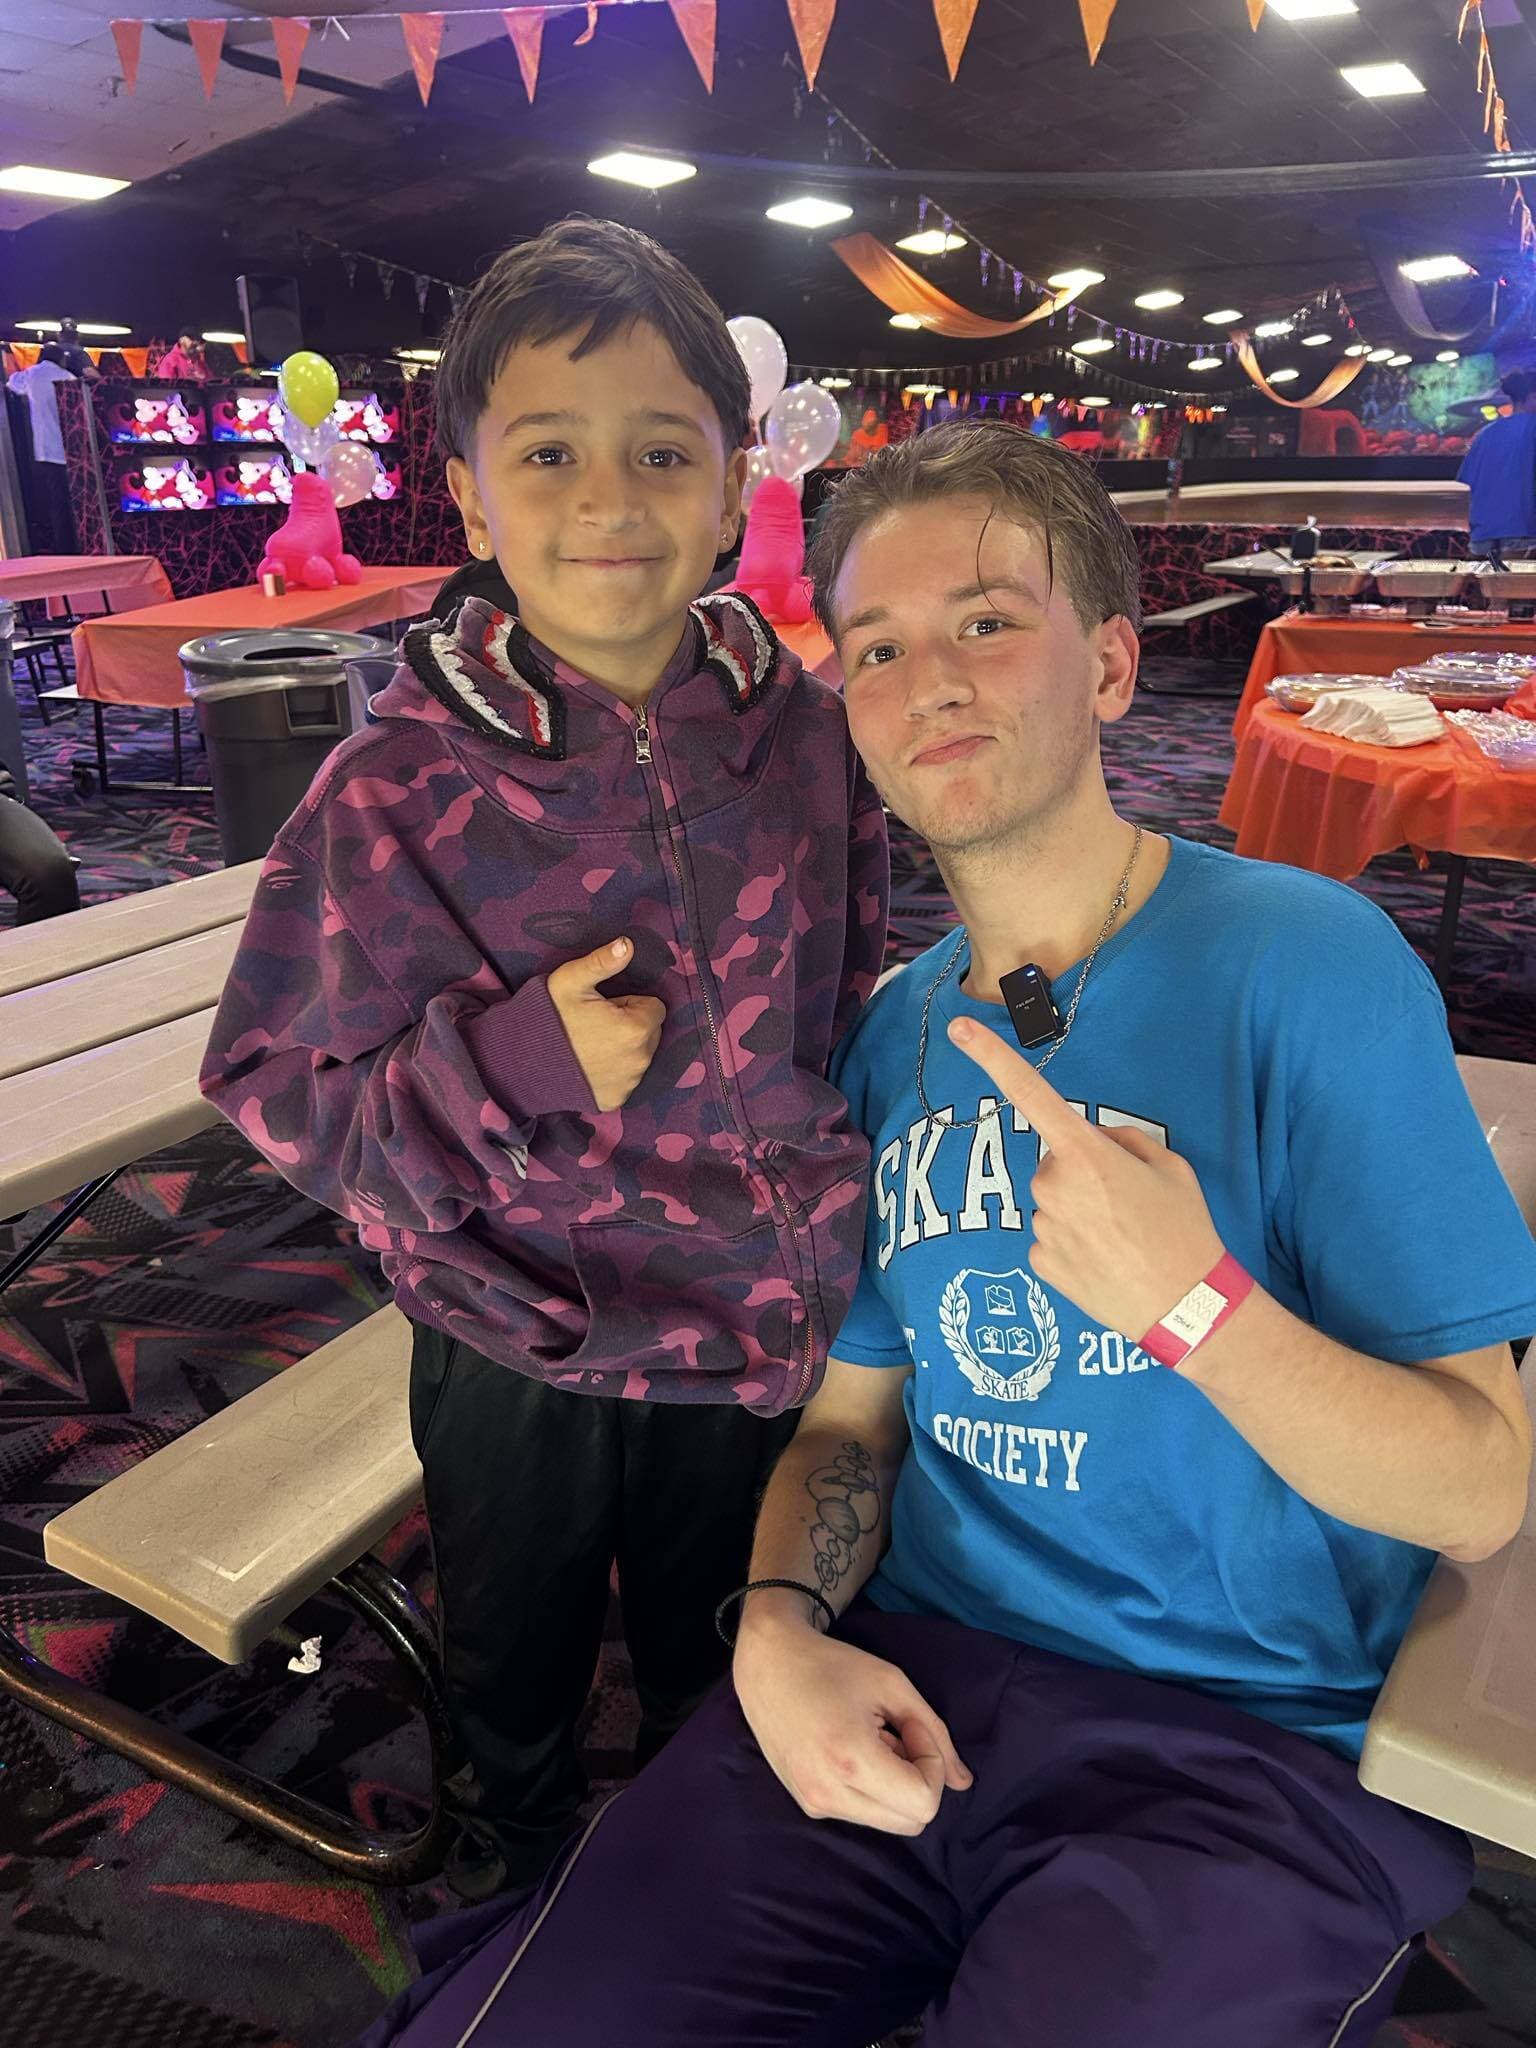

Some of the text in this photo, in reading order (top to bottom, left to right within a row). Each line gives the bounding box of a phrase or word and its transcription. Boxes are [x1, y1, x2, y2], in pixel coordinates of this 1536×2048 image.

[874, 1096, 1169, 1272] SKA
[1078, 1331, 1162, 1375] 202
[981, 1375, 1030, 1400] SKATE
[933, 1413, 1089, 1491] SOCIETY
